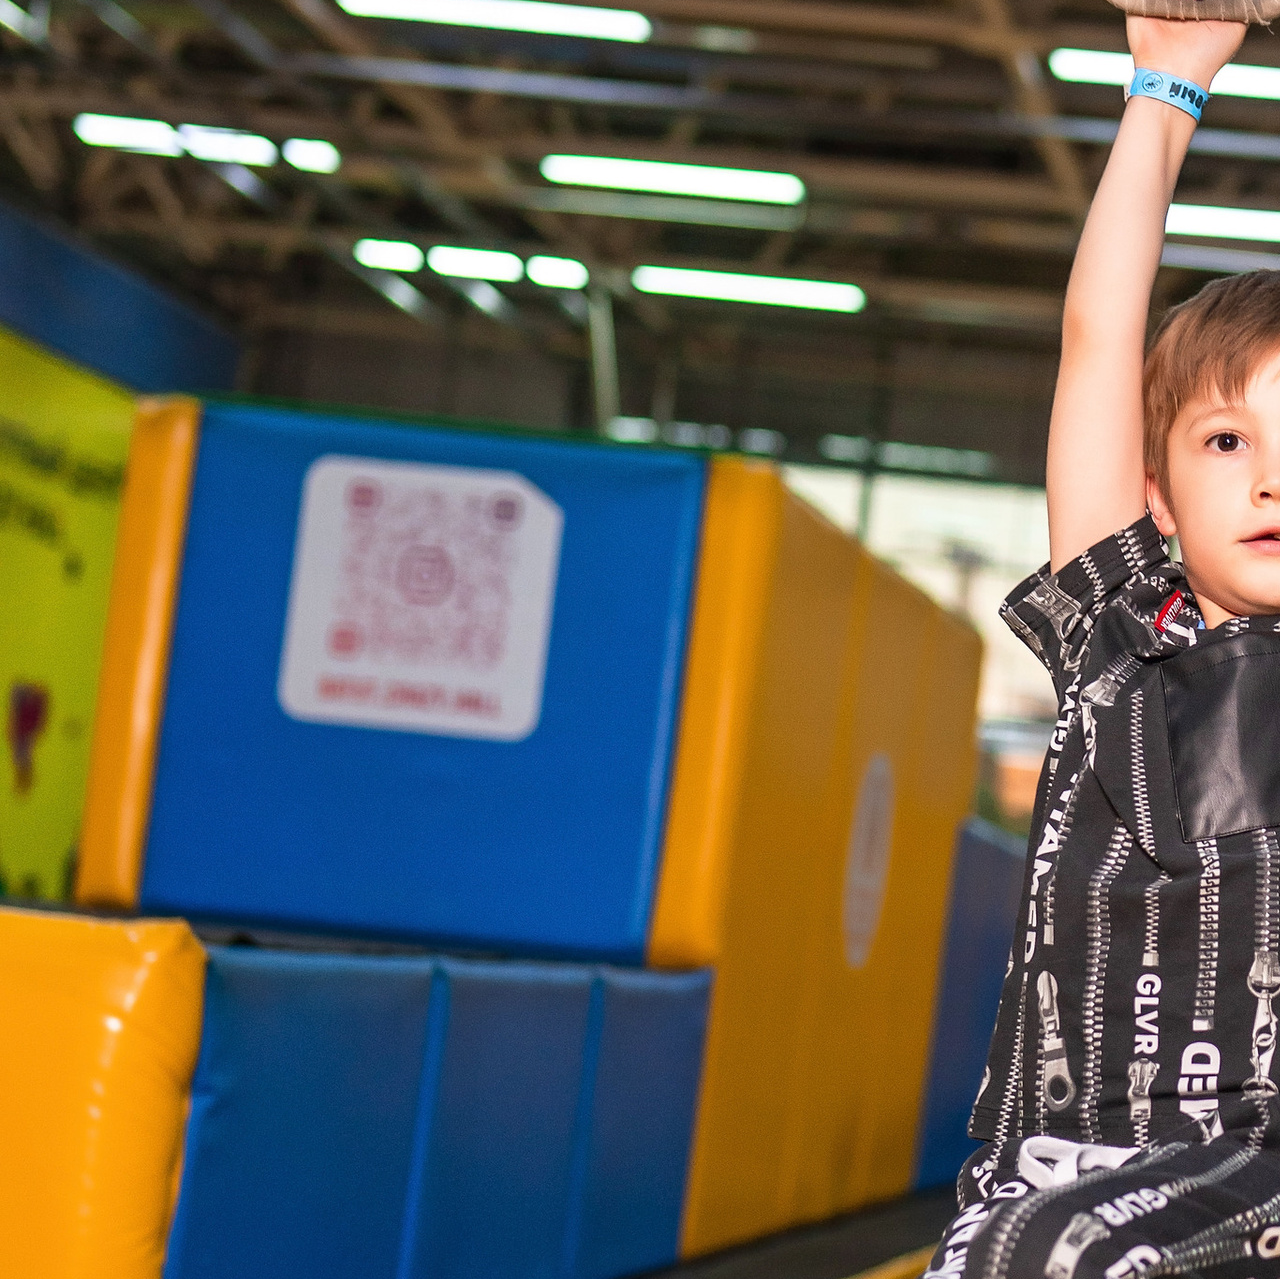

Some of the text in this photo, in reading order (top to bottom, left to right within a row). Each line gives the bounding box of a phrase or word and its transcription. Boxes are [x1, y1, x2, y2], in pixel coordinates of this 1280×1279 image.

[1160, 597, 1183, 630] GULLIVER
[1133, 973, 1162, 1055] GLVR
[1092, 1187, 1169, 1227] GLVR
